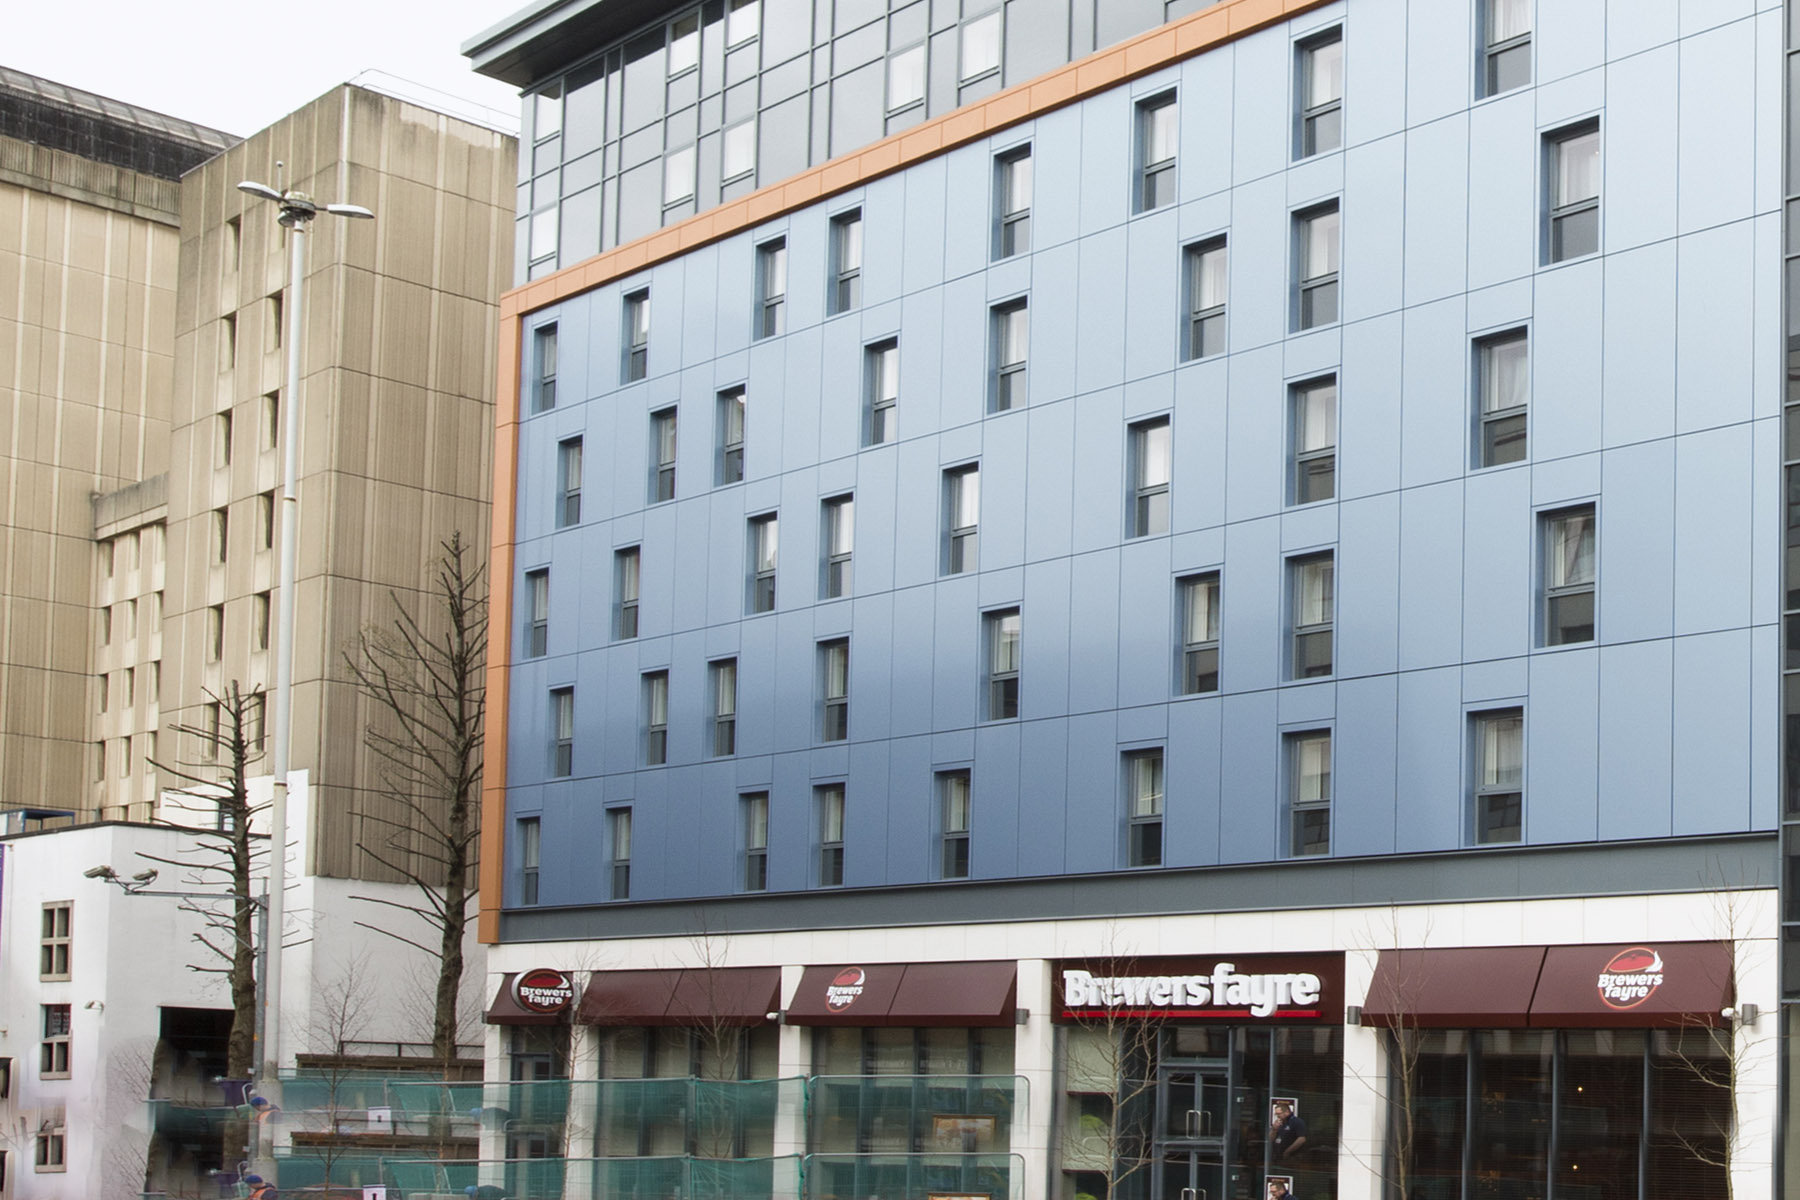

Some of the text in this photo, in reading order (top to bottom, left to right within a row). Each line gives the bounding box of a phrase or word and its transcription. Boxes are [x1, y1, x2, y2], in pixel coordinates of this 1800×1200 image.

[1598, 974, 1663, 987] Brewers
[520, 986, 573, 998] Brewers
[826, 986, 864, 997] Brewers
[1063, 963, 1321, 1017] Brewers fayre
[1604, 985, 1648, 1001] fayre
[528, 994, 563, 1006] fayre
